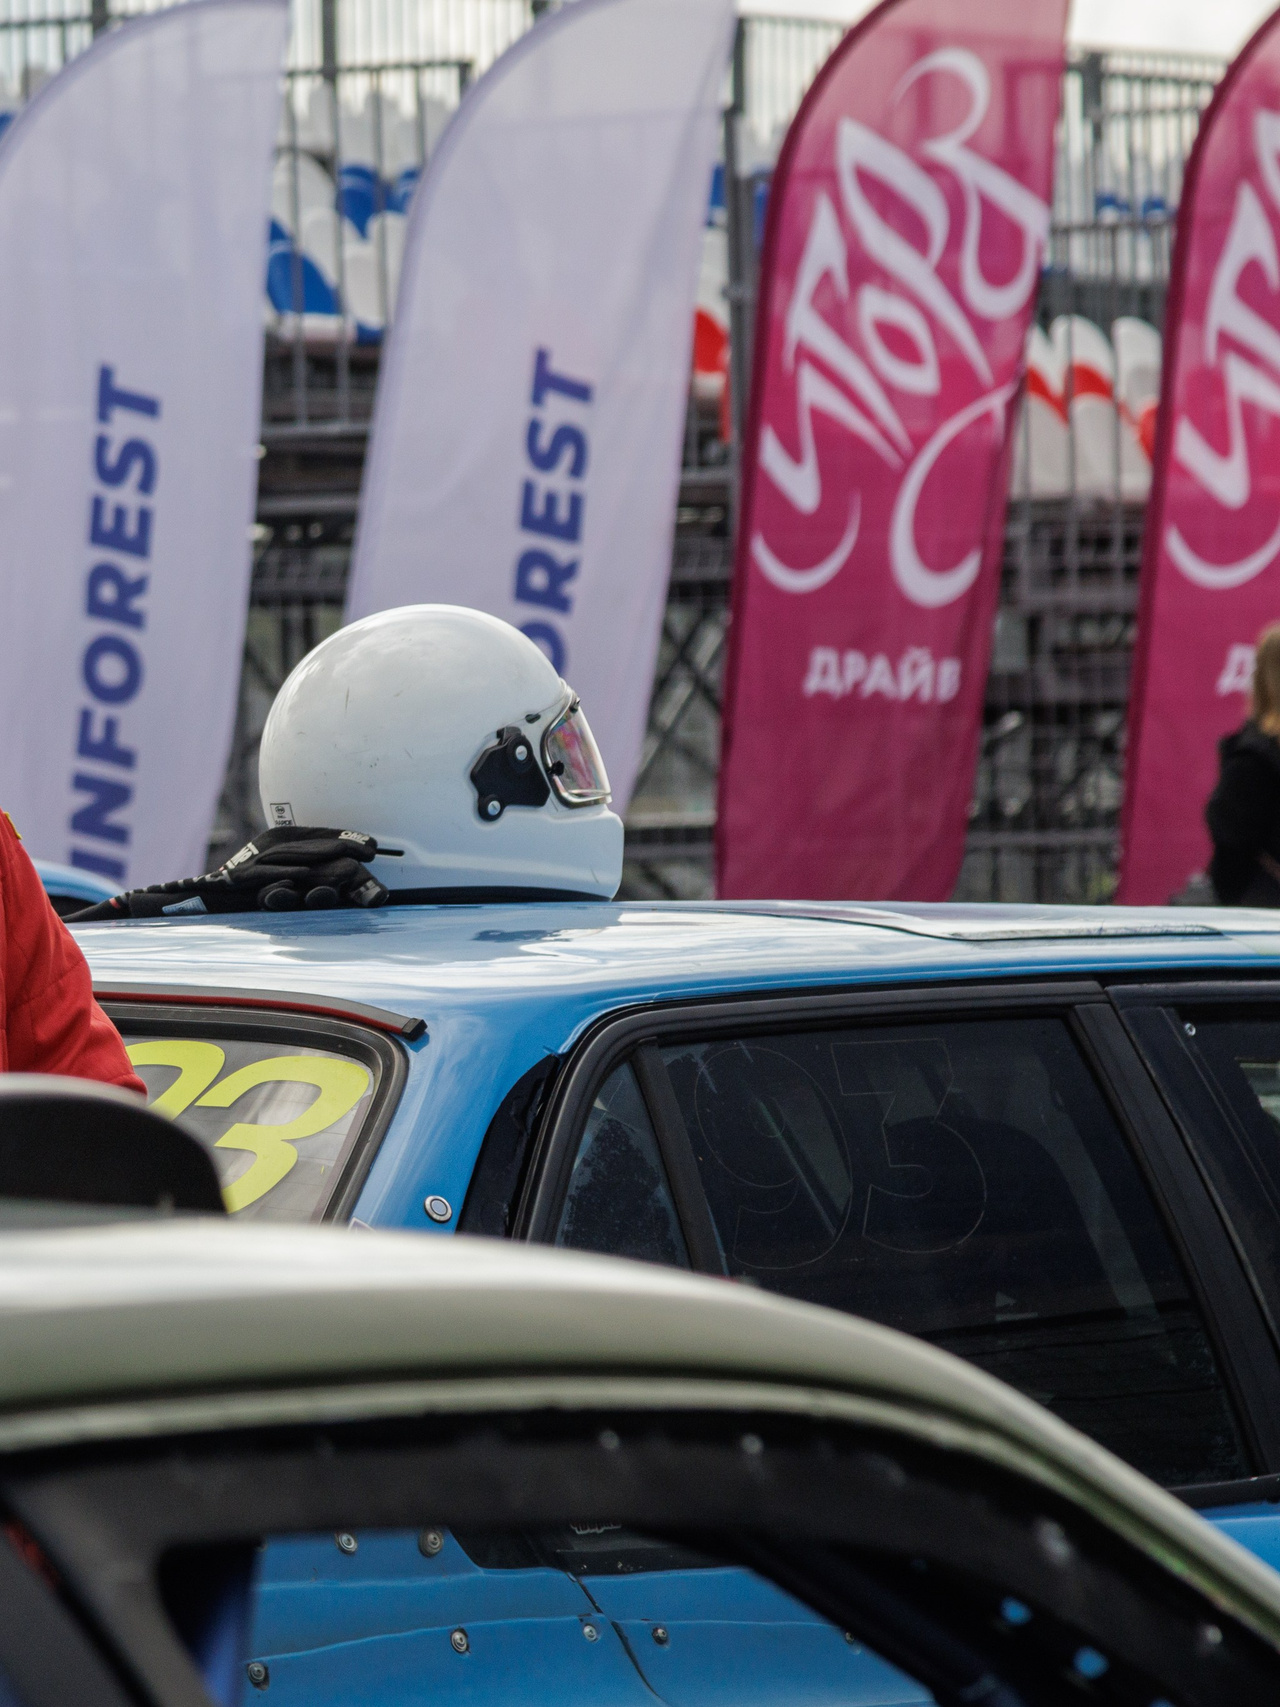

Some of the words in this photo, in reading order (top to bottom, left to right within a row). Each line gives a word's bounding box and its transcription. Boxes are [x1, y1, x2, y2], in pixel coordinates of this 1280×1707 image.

[70, 364, 163, 881] INFOREST
[516, 345, 594, 678] OREST
[804, 646, 961, 702] ДРАЙВ
[339, 831, 370, 844] OMP
[694, 1038, 987, 1269] 93
